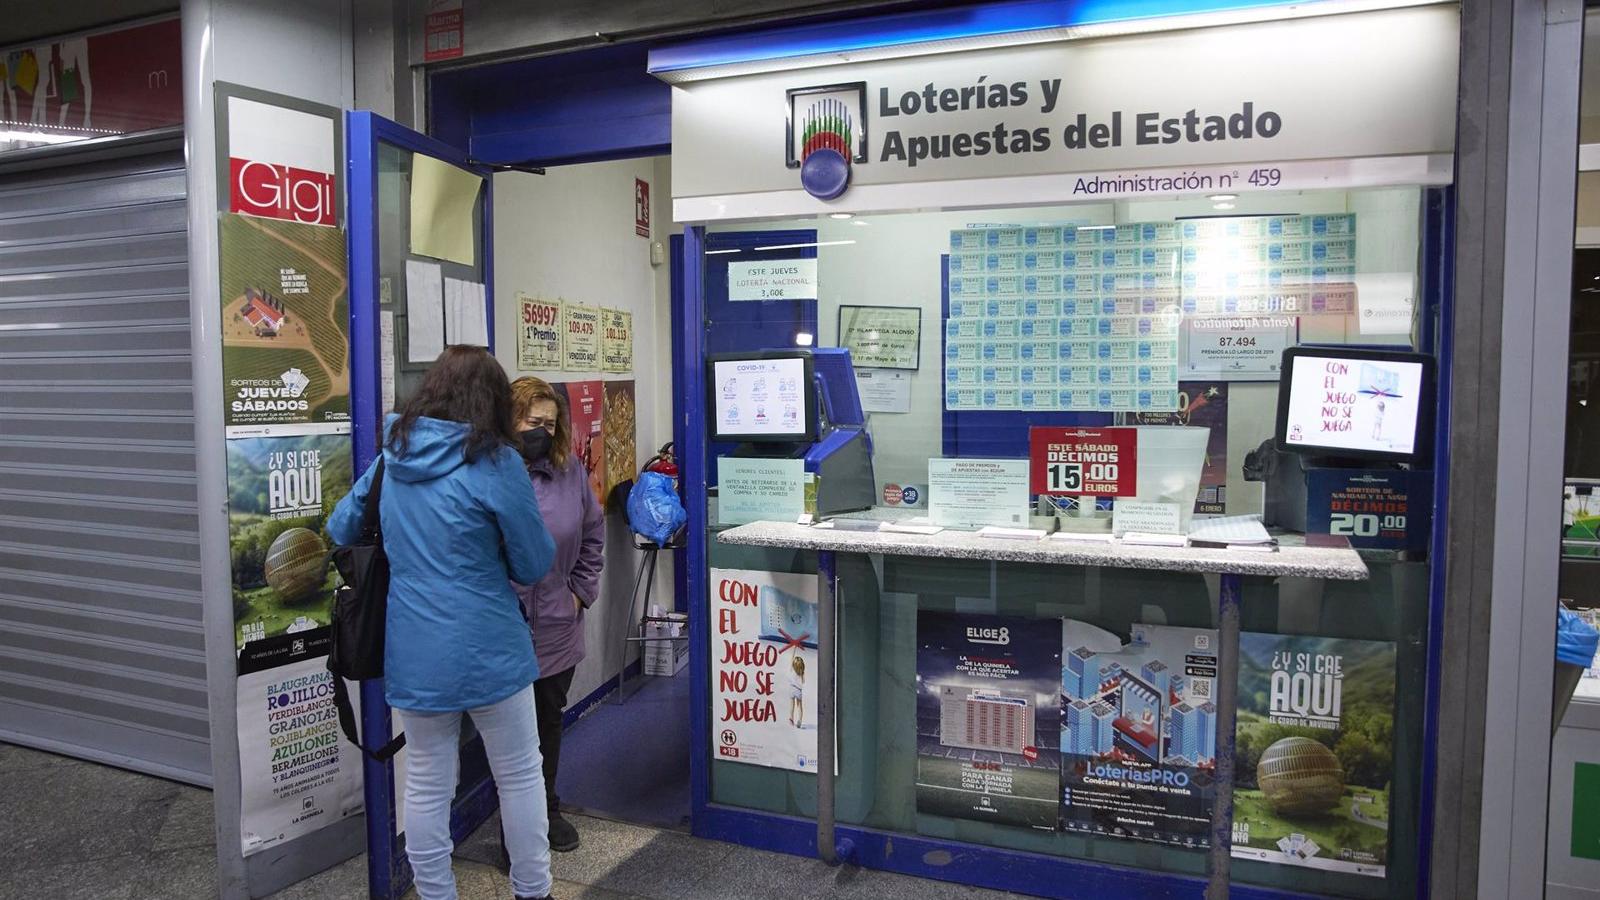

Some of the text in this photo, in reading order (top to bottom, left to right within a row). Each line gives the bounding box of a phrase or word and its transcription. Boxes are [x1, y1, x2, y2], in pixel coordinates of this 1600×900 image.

[879, 76, 1061, 118] Loterías y
[880, 101, 1283, 167] Apuestas del Estado
[1073, 168, 1281, 195] Administración nº 459
[239, 160, 331, 225] Gigi
[770, 267, 798, 275] JUEVES
[772, 277, 809, 286] NACIONAL
[523, 303, 557, 326] 56997
[534, 328, 557, 341] Premio
[568, 321, 594, 335] 109.479
[1219, 337, 1256, 347] 87.494
[1326, 361, 1349, 375] CON
[231, 379, 282, 387] SORTEOS DE
[1324, 376, 1335, 389] EL
[238, 387, 300, 399] JUEVES
[1322, 392, 1356, 404] JUEGO
[231, 398, 309, 412] SÁBADOS
[1321, 406, 1352, 418] NO SE
[1320, 420, 1352, 433] JUEGA
[1048, 442, 1118, 452] ESTE SÁBADO
[268, 450, 321, 470] ¿Y SI CAE
[1048, 450, 1118, 463] DÉCIMOS
[269, 465, 322, 509] AQUÍ
[1085, 484, 1118, 493] EUROS
[1331, 501, 1408, 512] DÉCIMOS
[719, 579, 758, 607] CON
[719, 608, 741, 634] EL
[720, 639, 778, 667] JUEGO
[1272, 651, 1343, 675] ¿Y SI CAE
[720, 669, 775, 696] NO SE
[1269, 670, 1345, 718] AQUÍ
[268, 697, 334, 722] VERDIBLANCO
[720, 698, 777, 723] JUEGA
[269, 707, 337, 735] GRANOTAS
[270, 720, 338, 747] ROJIBLANCOS
[271, 731, 338, 761] AZULONES
[722, 747, 737, 757] +18
[272, 745, 339, 774] BERMELLONES
[294, 773, 320, 788] ANIMANDO
[962, 771, 983, 780] PARA
[985, 774, 1013, 783] GANAR
[291, 785, 313, 796] COLORES
[1083, 776, 1120, 788] Conéctate
[1127, 781, 1136, 789] tu
[1136, 782, 1158, 792] punto
[1170, 787, 1191, 796] venta
[1240, 823, 1249, 831] LA
